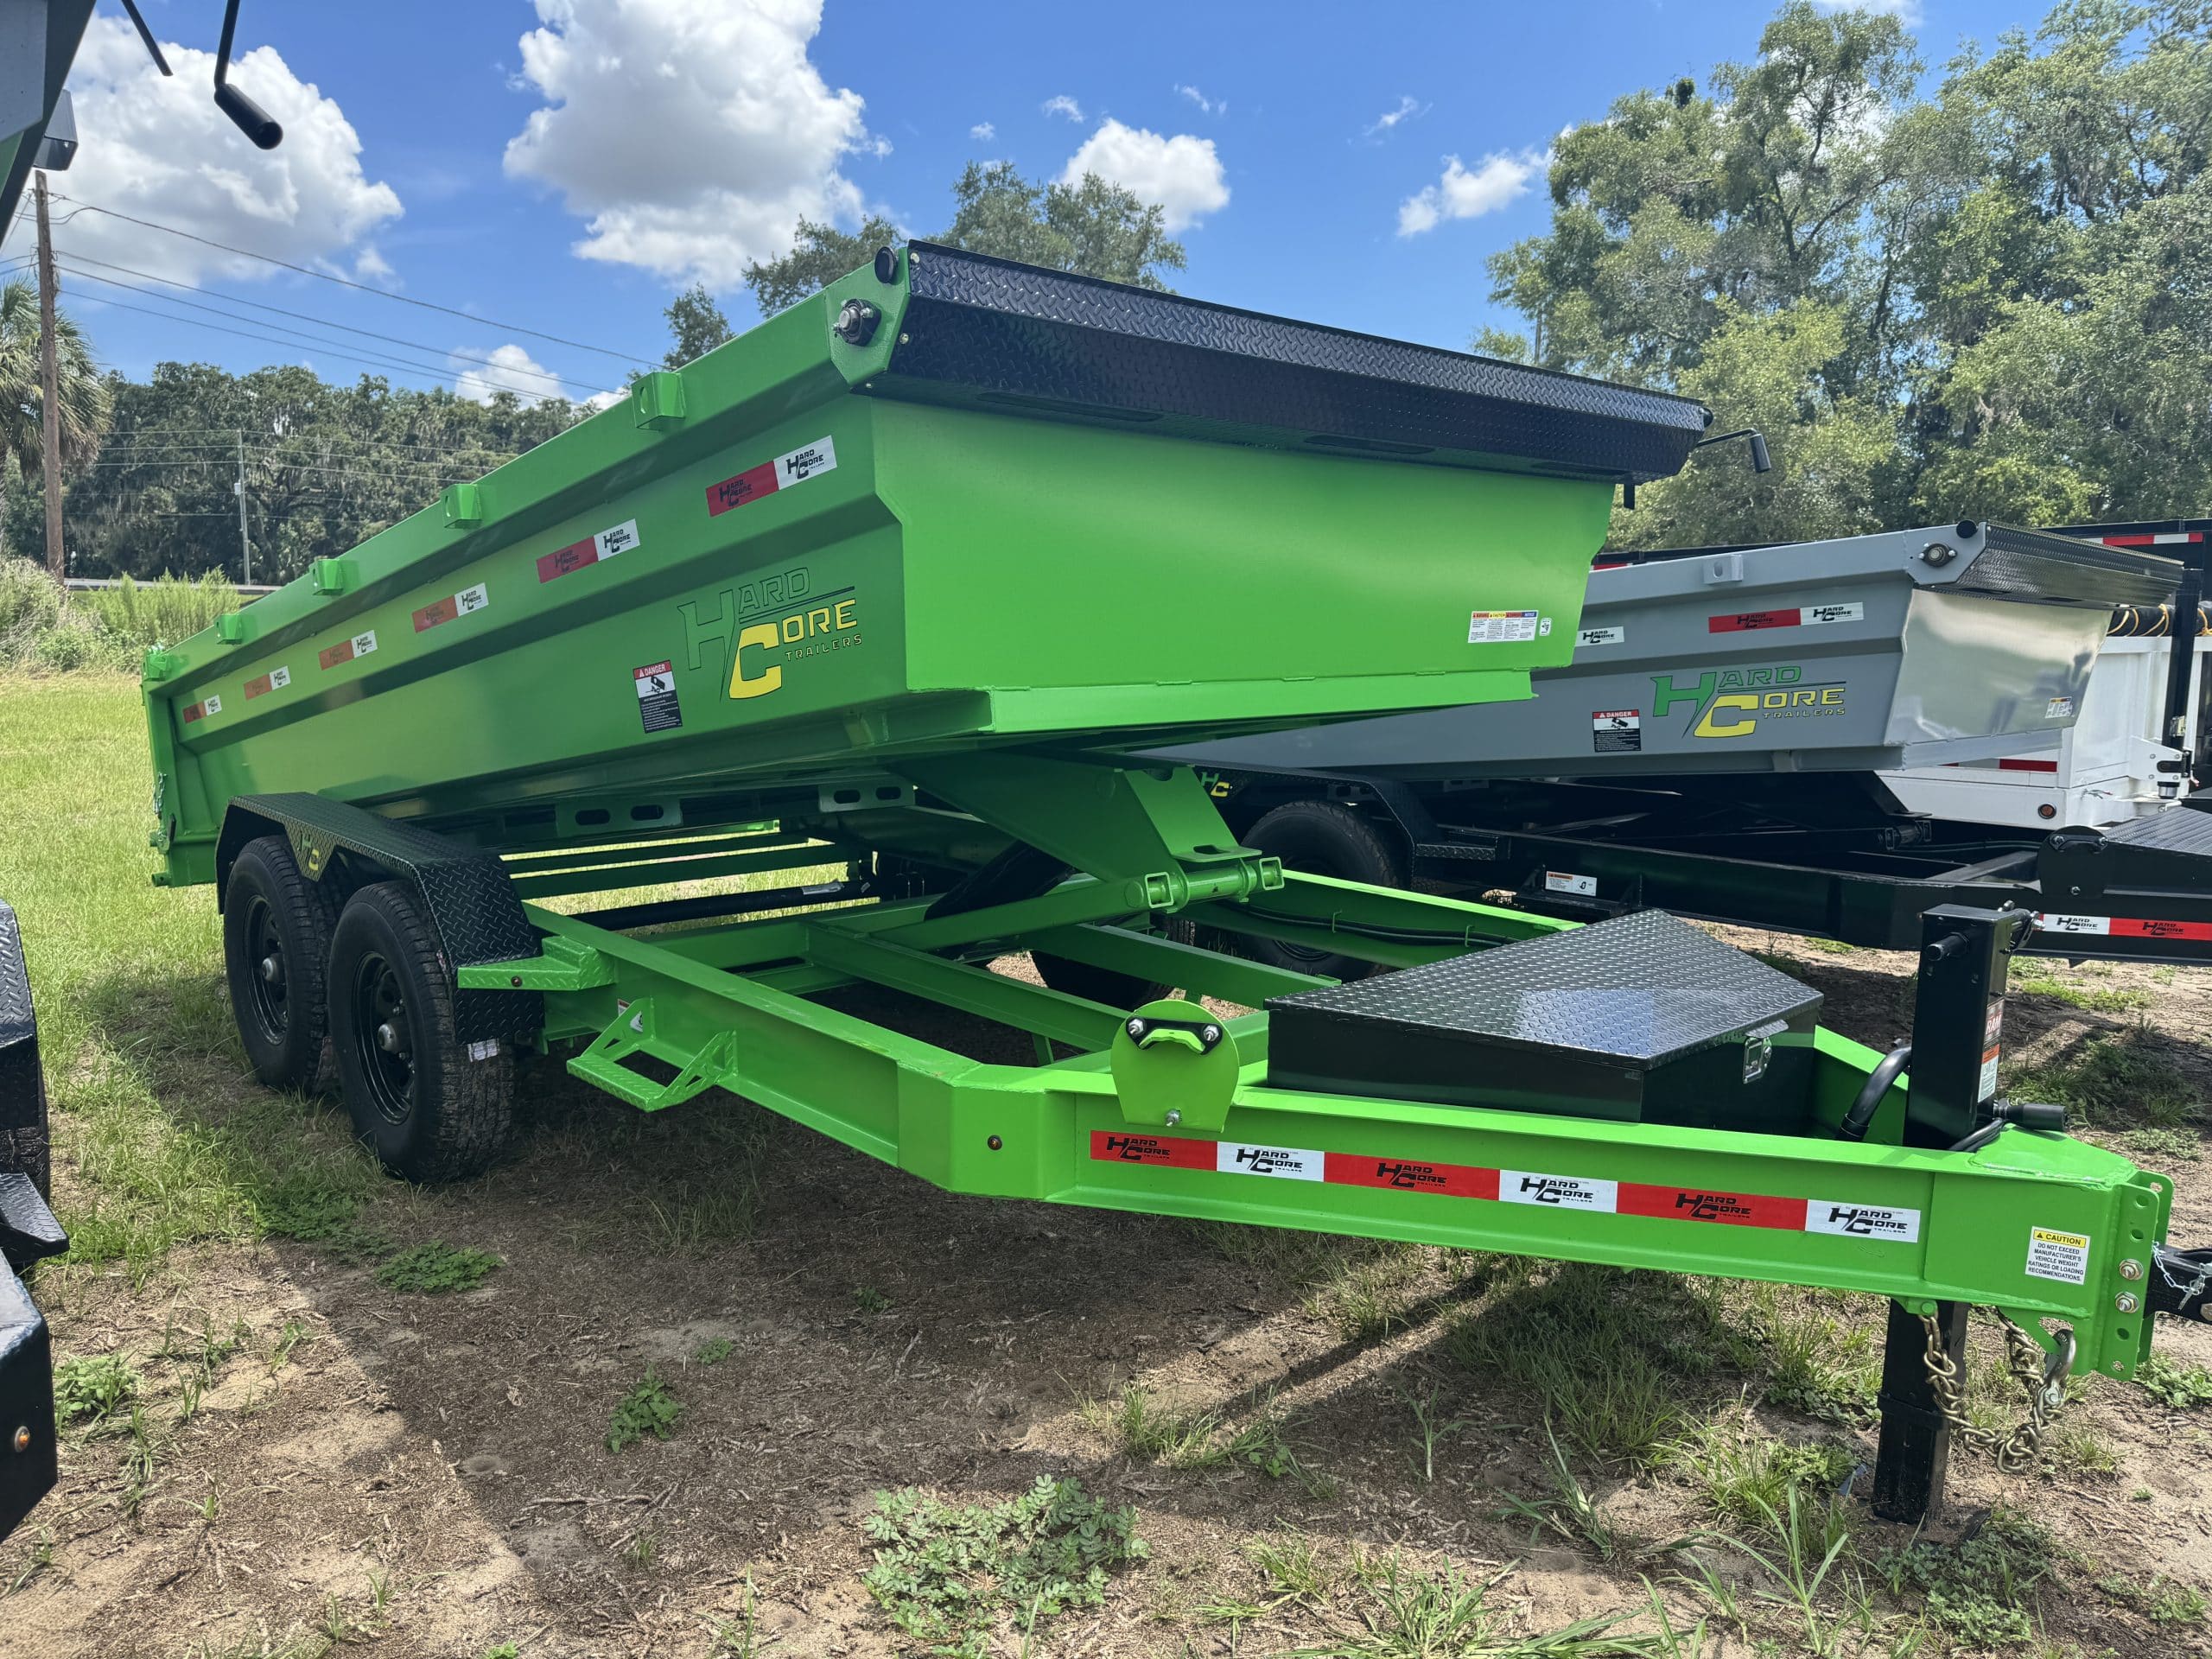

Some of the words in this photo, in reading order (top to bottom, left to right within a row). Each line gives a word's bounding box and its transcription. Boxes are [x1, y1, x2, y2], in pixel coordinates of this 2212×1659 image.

[785, 448, 815, 474] HARD
[796, 454, 824, 480] CORE
[1813, 606, 1844, 620] HARD
[1821, 610, 1853, 622] CORE
[677, 567, 810, 702] HARD
[729, 598, 858, 700] CORE
[785, 634, 863, 662] TRAILERS
[645, 664, 666, 676] DANGER
[1650, 666, 1802, 738] HARD
[1694, 688, 1847, 739] CORE
[1763, 708, 1847, 719] TRAILERS
[2056, 917, 2090, 927] HARD
[2064, 922, 2098, 931] CORE
[1106, 1136, 1158, 1155] HARD
[1120, 1146, 1170, 1160] CORE
[1236, 1148, 1289, 1169] HARD
[1249, 1158, 1303, 1173] CORE
[1376, 1162, 1433, 1184] HARD
[1391, 1173, 1447, 1188] CORE
[1520, 1177, 1580, 1199] HARD
[1535, 1187, 1594, 1204] CORE
[1675, 1193, 1737, 1215] HARD
[1691, 1203, 1751, 1219] CORE
[1828, 1207, 1892, 1230] HARD
[1845, 1217, 1908, 1235] CORE
[2045, 1233, 2082, 1245] CAUTION
[2034, 1249, 2082, 1262] MANUFACTURER'S
[2058, 1246, 2080, 1255] EXCEED
[2028, 1260, 2050, 1268] RATINGS
[2060, 1266, 2084, 1275] LOADING
[2035, 1255, 2057, 1264] VEHICLE
[2057, 1259, 2079, 1268] WEIGHT
